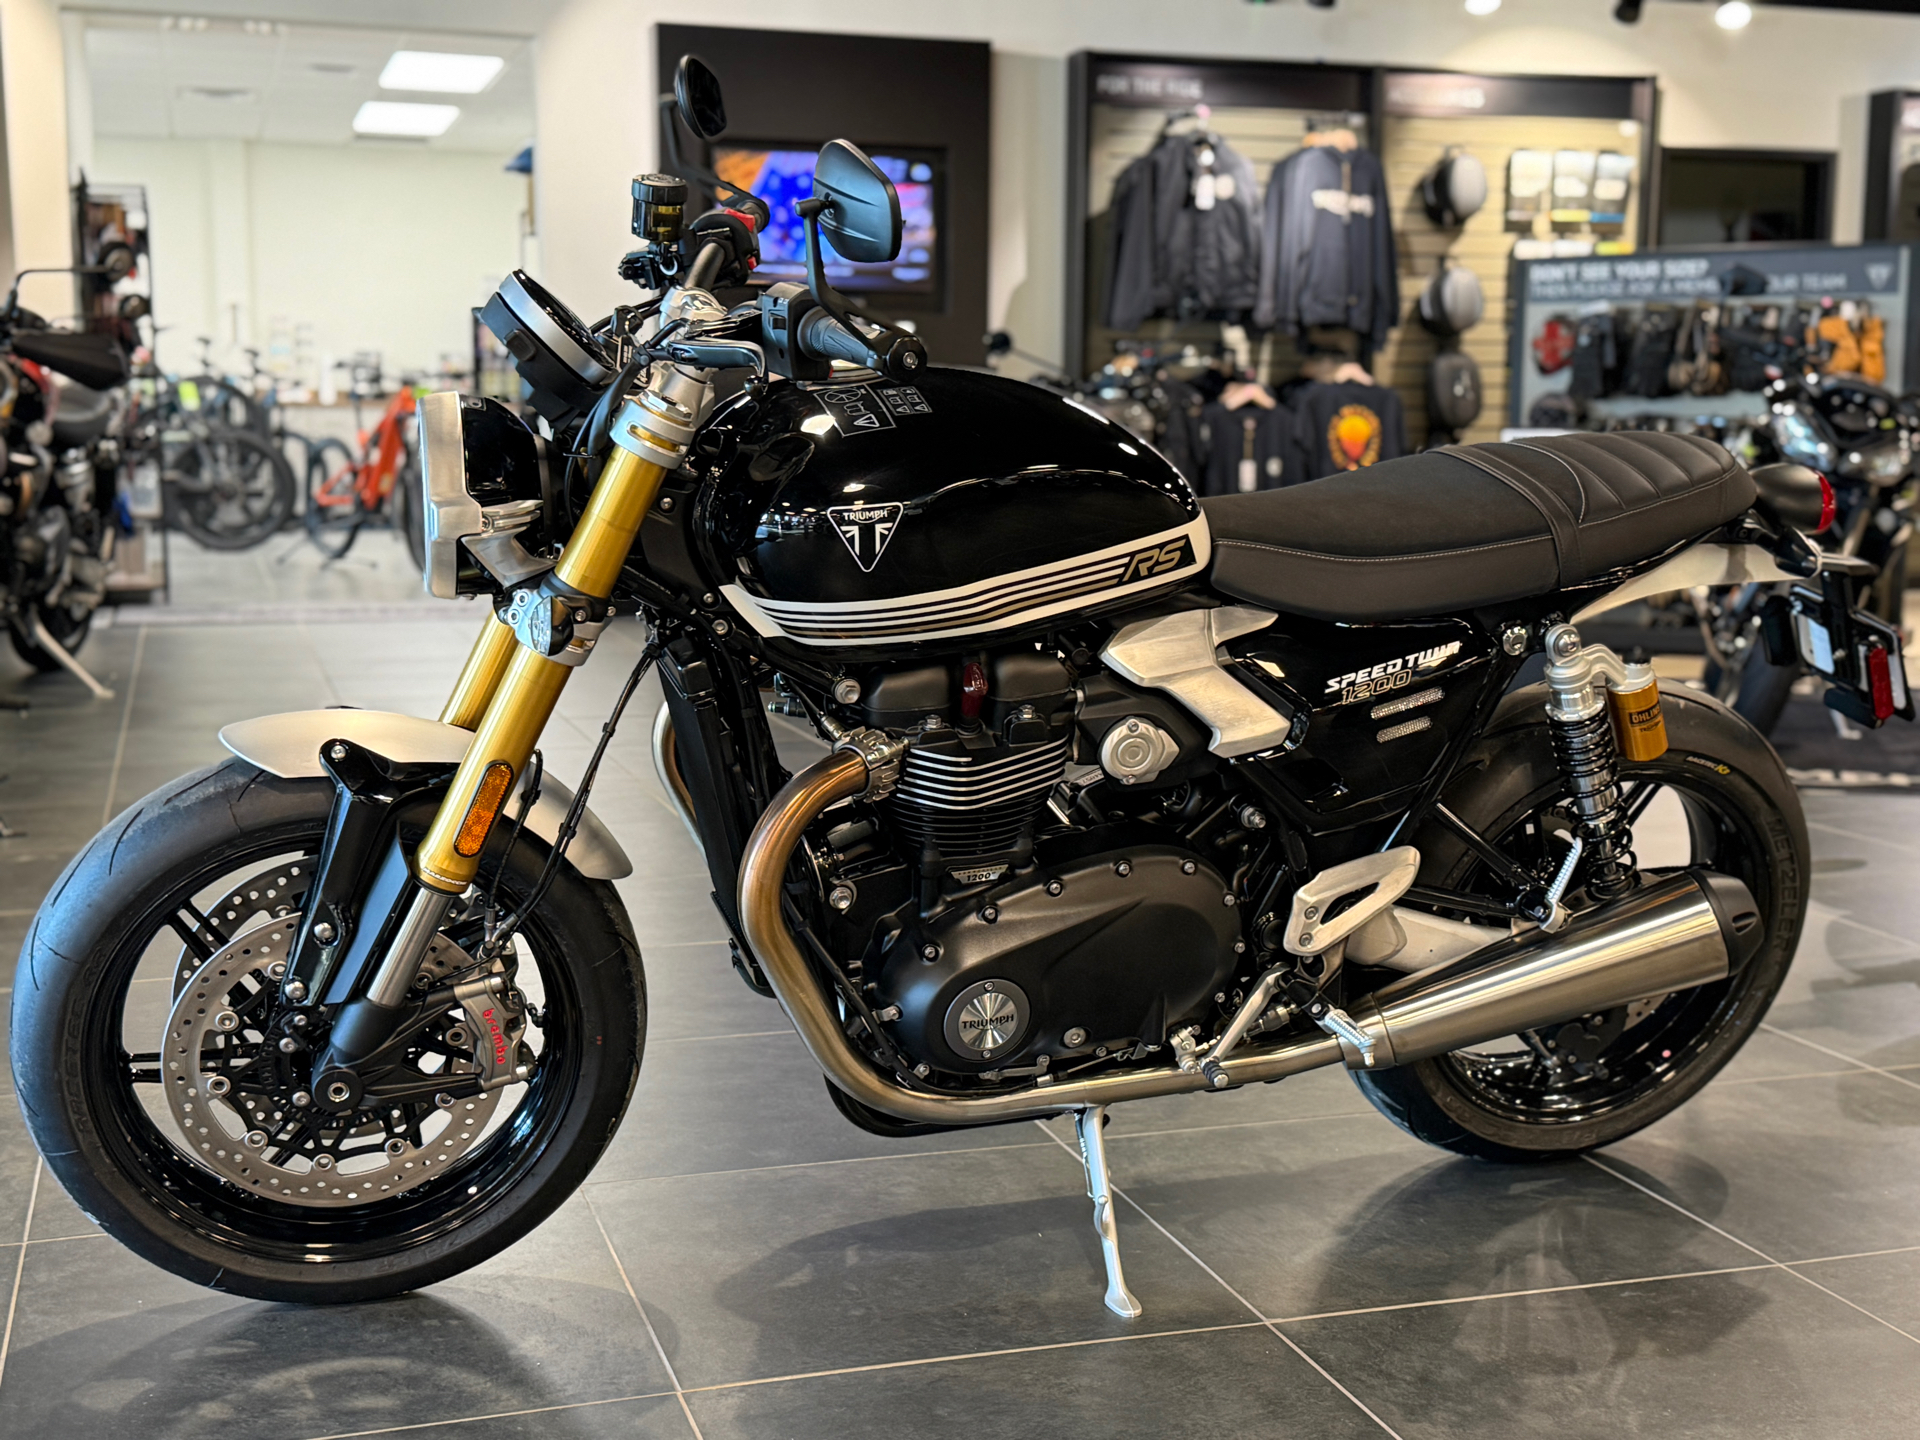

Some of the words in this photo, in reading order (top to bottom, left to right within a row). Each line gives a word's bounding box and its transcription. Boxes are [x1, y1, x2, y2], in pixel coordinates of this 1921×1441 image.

[842, 510, 888, 523] TRIUMPH
[1122, 539, 1187, 582] RS
[1324, 658, 1403, 694] SPEED
[1341, 669, 1412, 705] 1200
[966, 872, 991, 882] 1200
[1766, 817, 1798, 952] METZELER
[483, 1008, 509, 1065] brembo
[961, 1014, 1015, 1031] TRIUMPH
